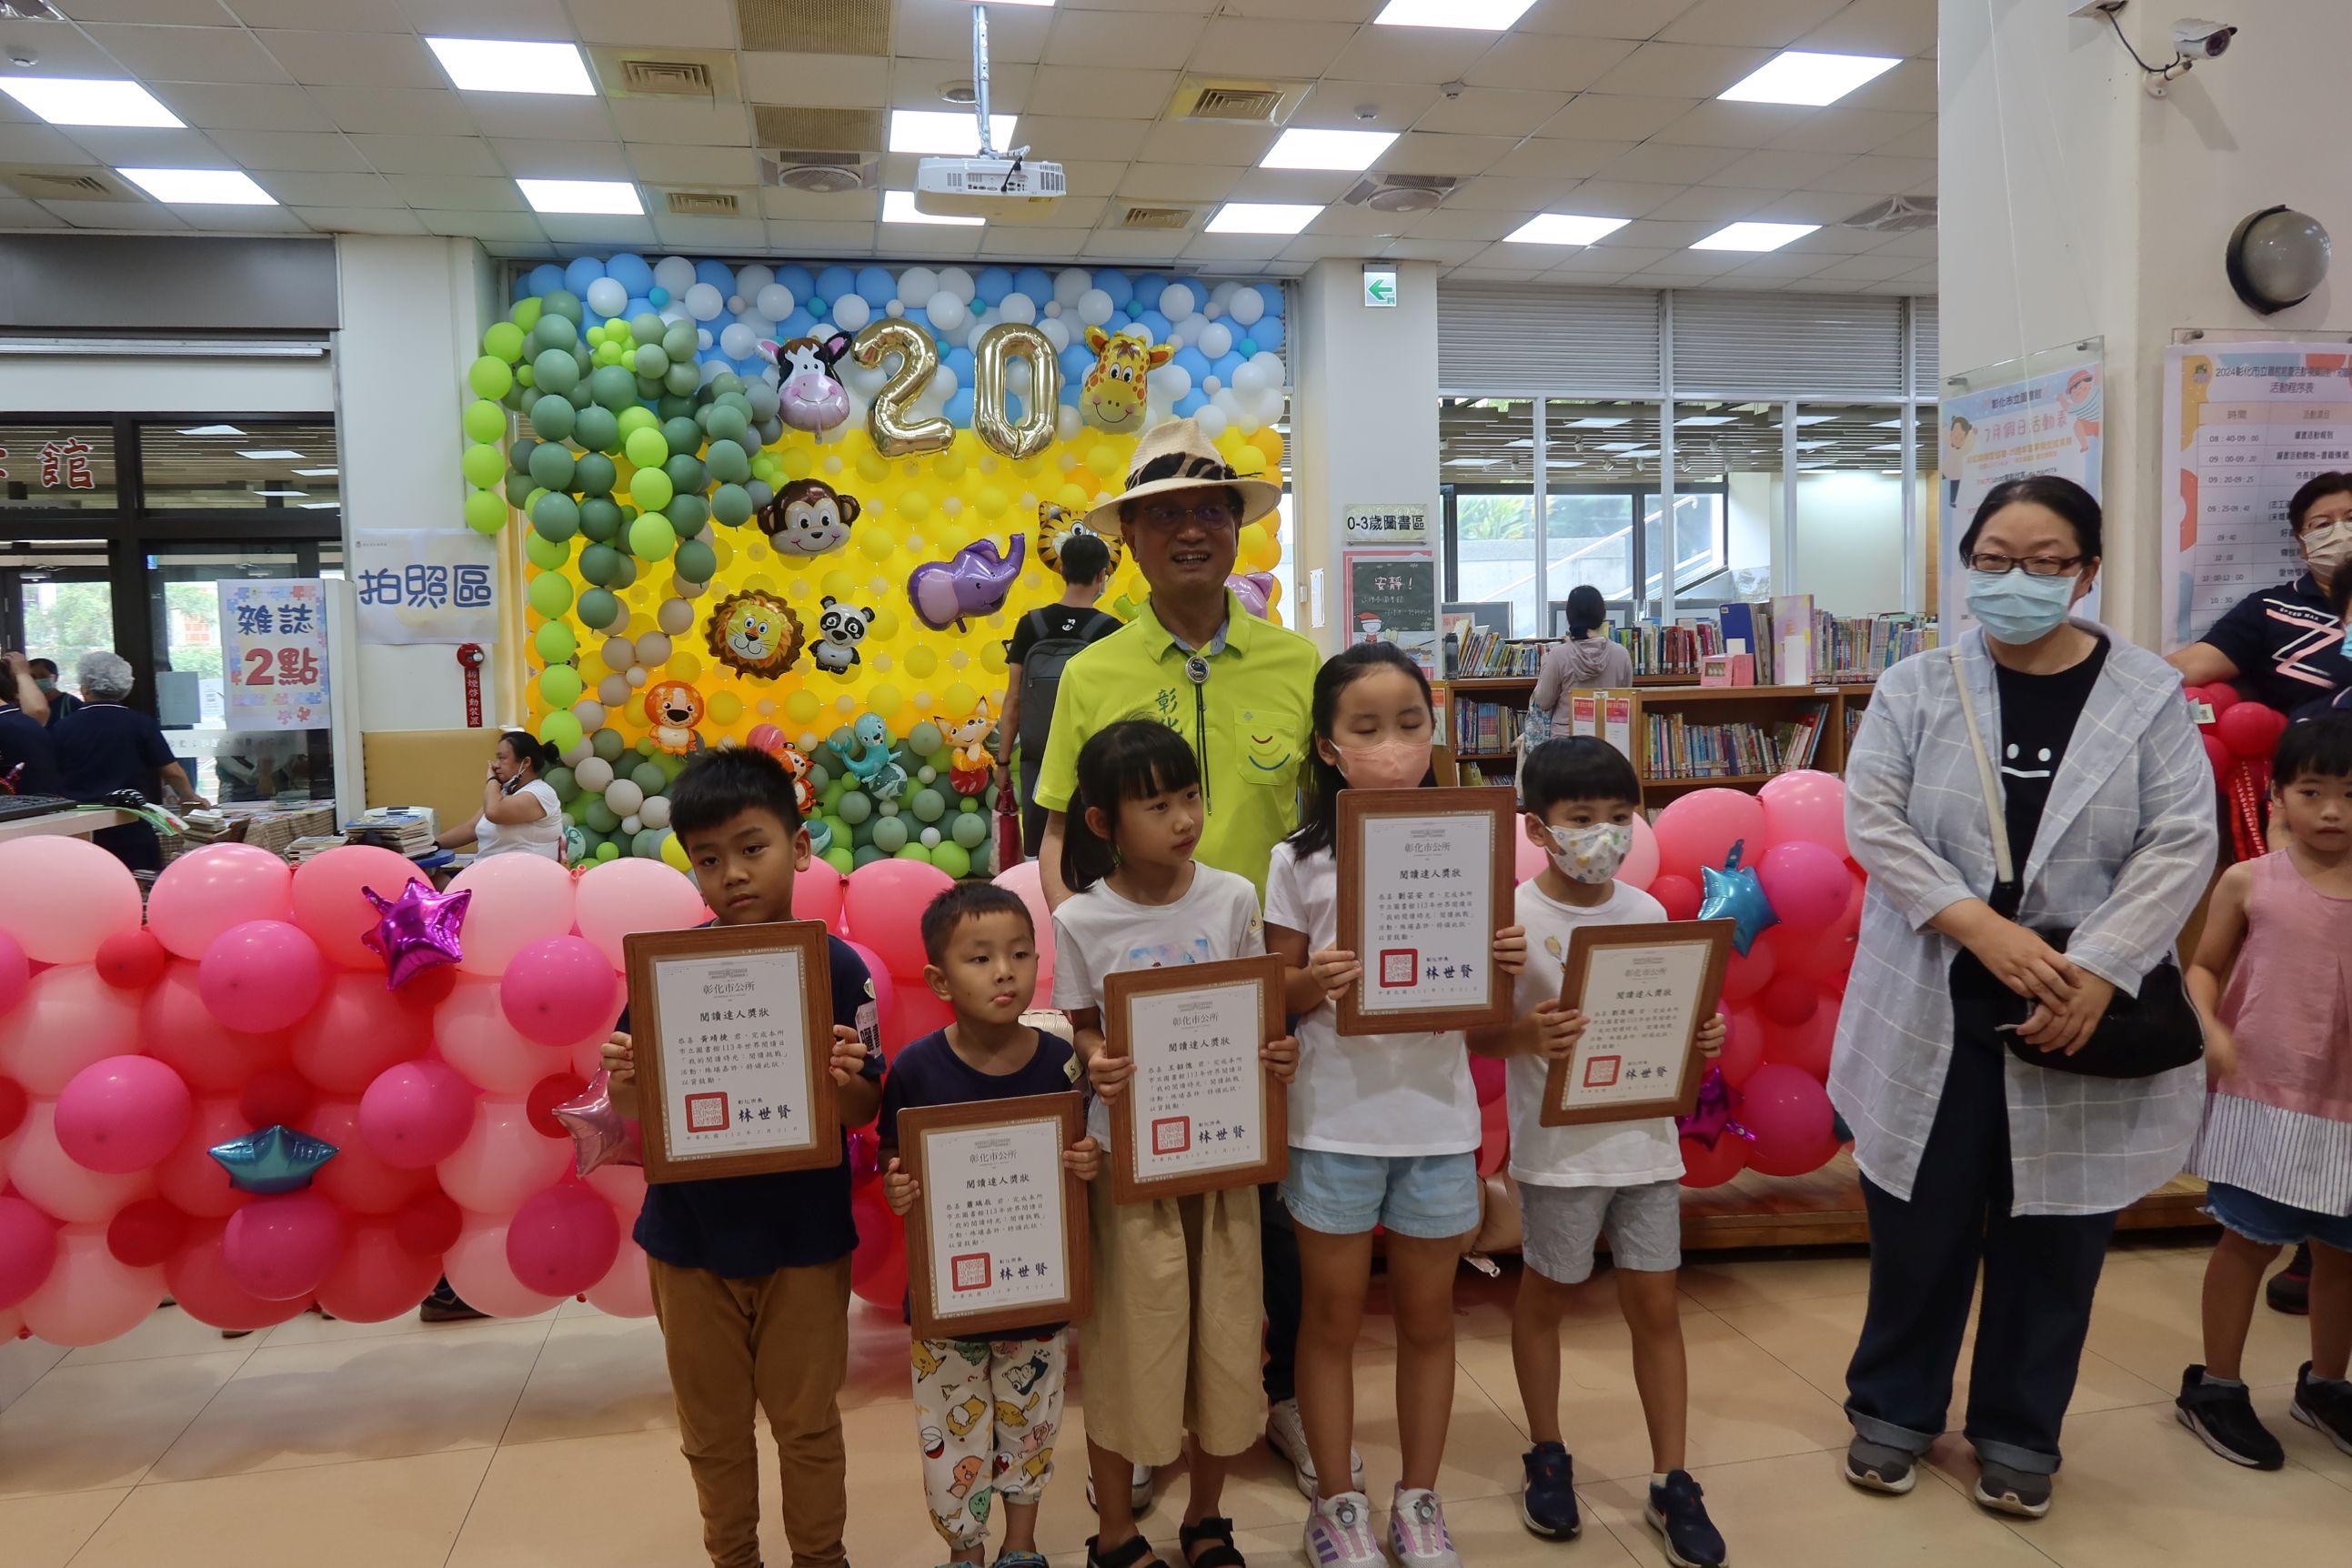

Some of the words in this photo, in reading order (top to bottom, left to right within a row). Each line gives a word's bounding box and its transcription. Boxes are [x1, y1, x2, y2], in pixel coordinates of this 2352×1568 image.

[851, 317, 1060, 459] 20
[1347, 515, 1425, 530] 0-3歲圖書區
[358, 564, 492, 609] 拍照區
[236, 603, 314, 635] 雜誌
[245, 647, 318, 686] 2點
[1403, 841, 1450, 852] 彰化市公所
[1399, 868, 1461, 879] 閱讀達人獎狀
[1425, 963, 1473, 980] 林世賢
[702, 981, 755, 994] 彰化市公所
[699, 1007, 769, 1021] 閱讀達人獎狀
[1171, 1012, 1218, 1026] 彰化市公所
[1168, 1036, 1230, 1051] 閱讀達人獎狀
[738, 1103, 791, 1123] 林世賢
[1198, 1124, 1245, 1144] 林世賢
[969, 1150, 1017, 1163] 彰化市公所
[966, 1173, 1030, 1189] 閱讀達人獎狀
[1000, 1261, 1048, 1282] 林世賢
